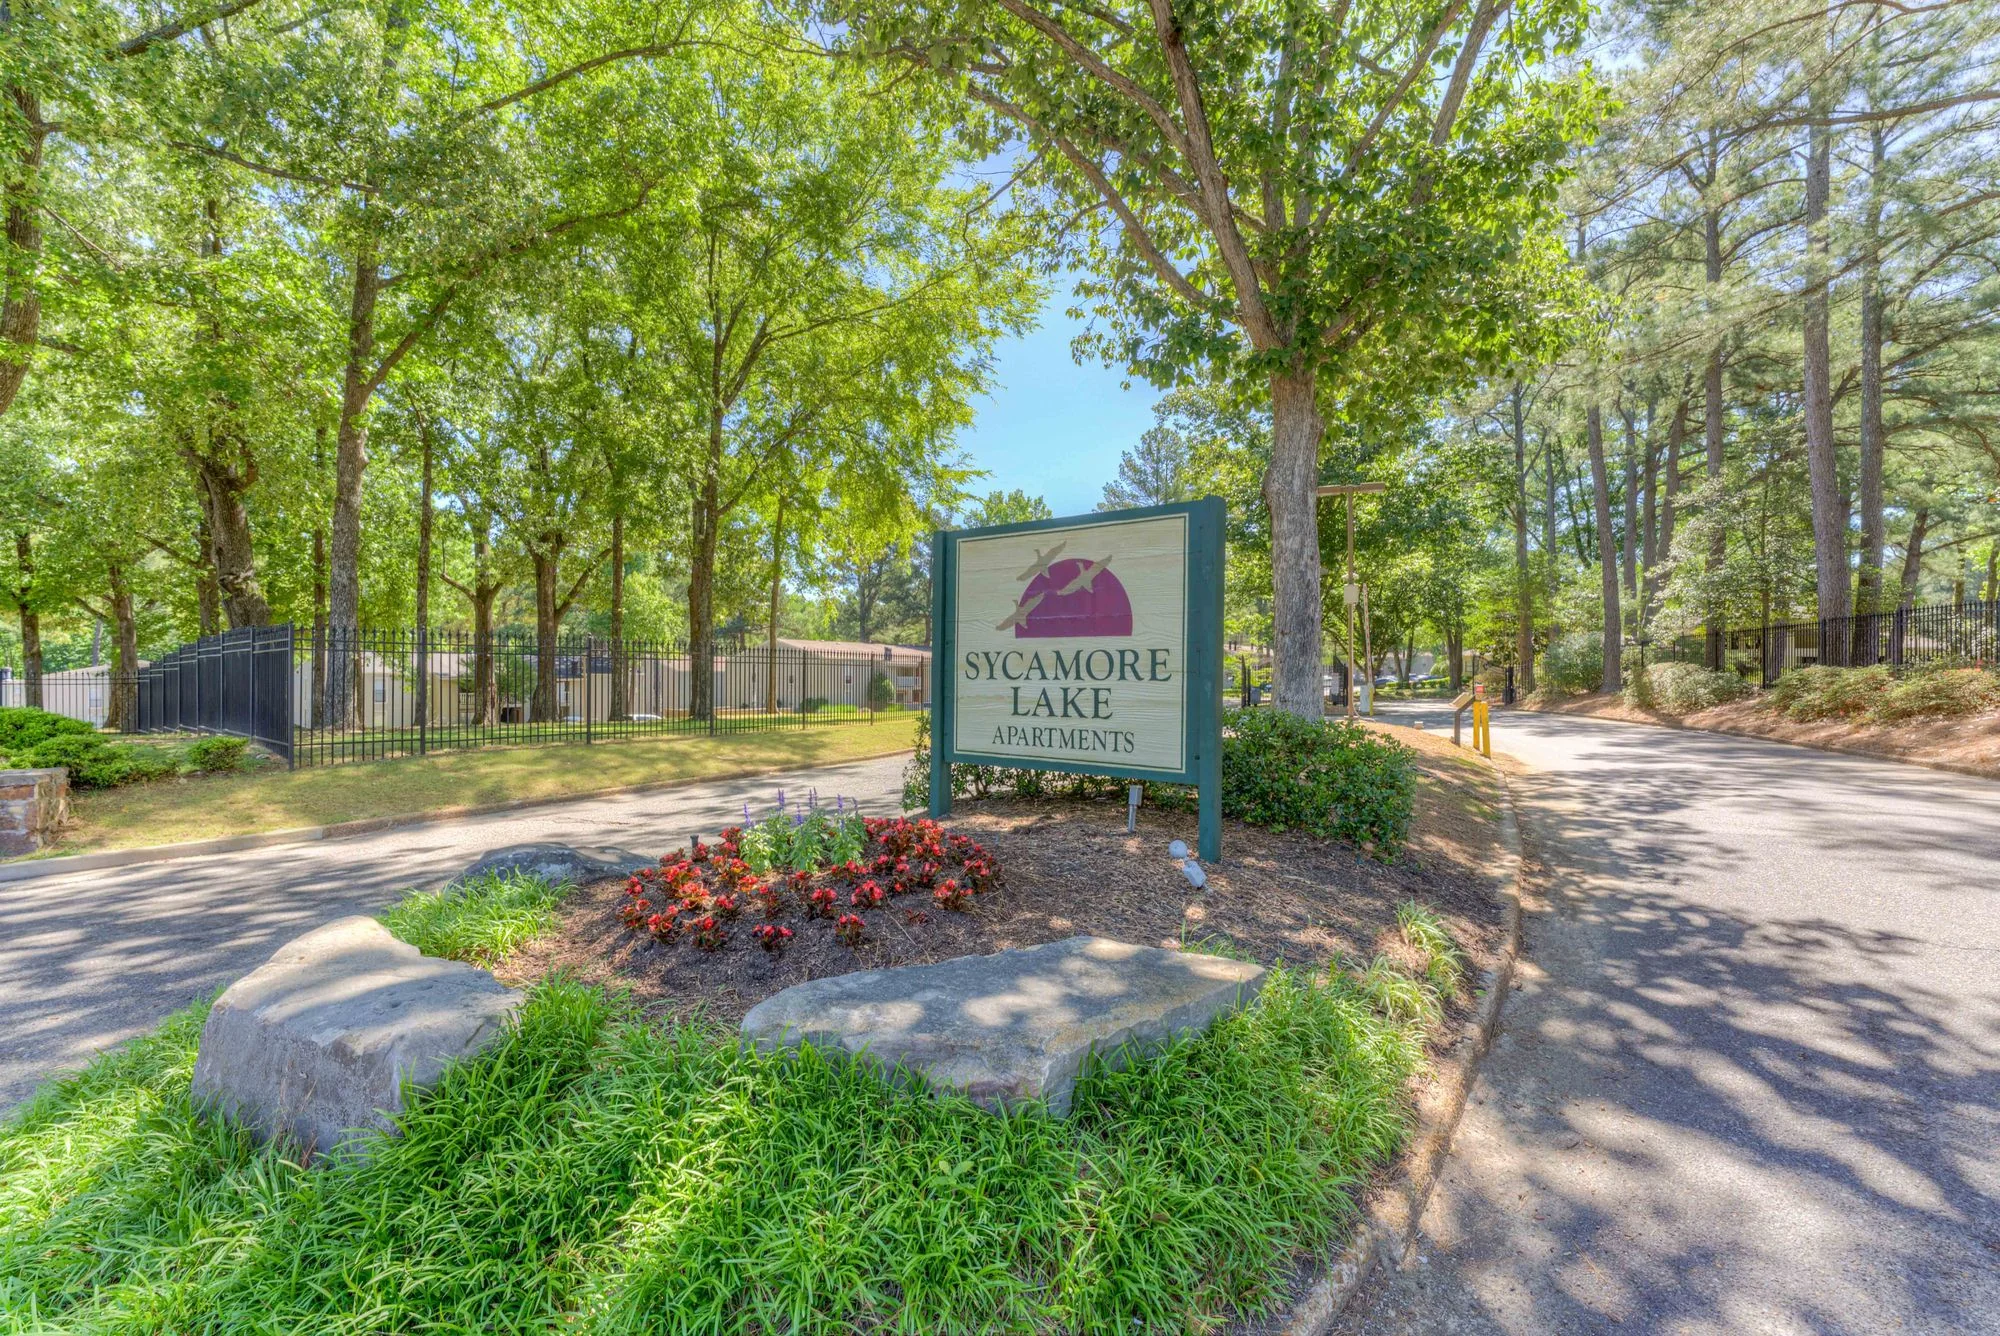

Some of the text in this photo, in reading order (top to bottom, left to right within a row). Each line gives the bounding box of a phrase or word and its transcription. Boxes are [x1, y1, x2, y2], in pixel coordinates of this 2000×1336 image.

[965, 648, 1172, 682] SYCAMORE
[1011, 686, 1113, 720] LAKE
[992, 725, 1135, 754] APARTMENTS
